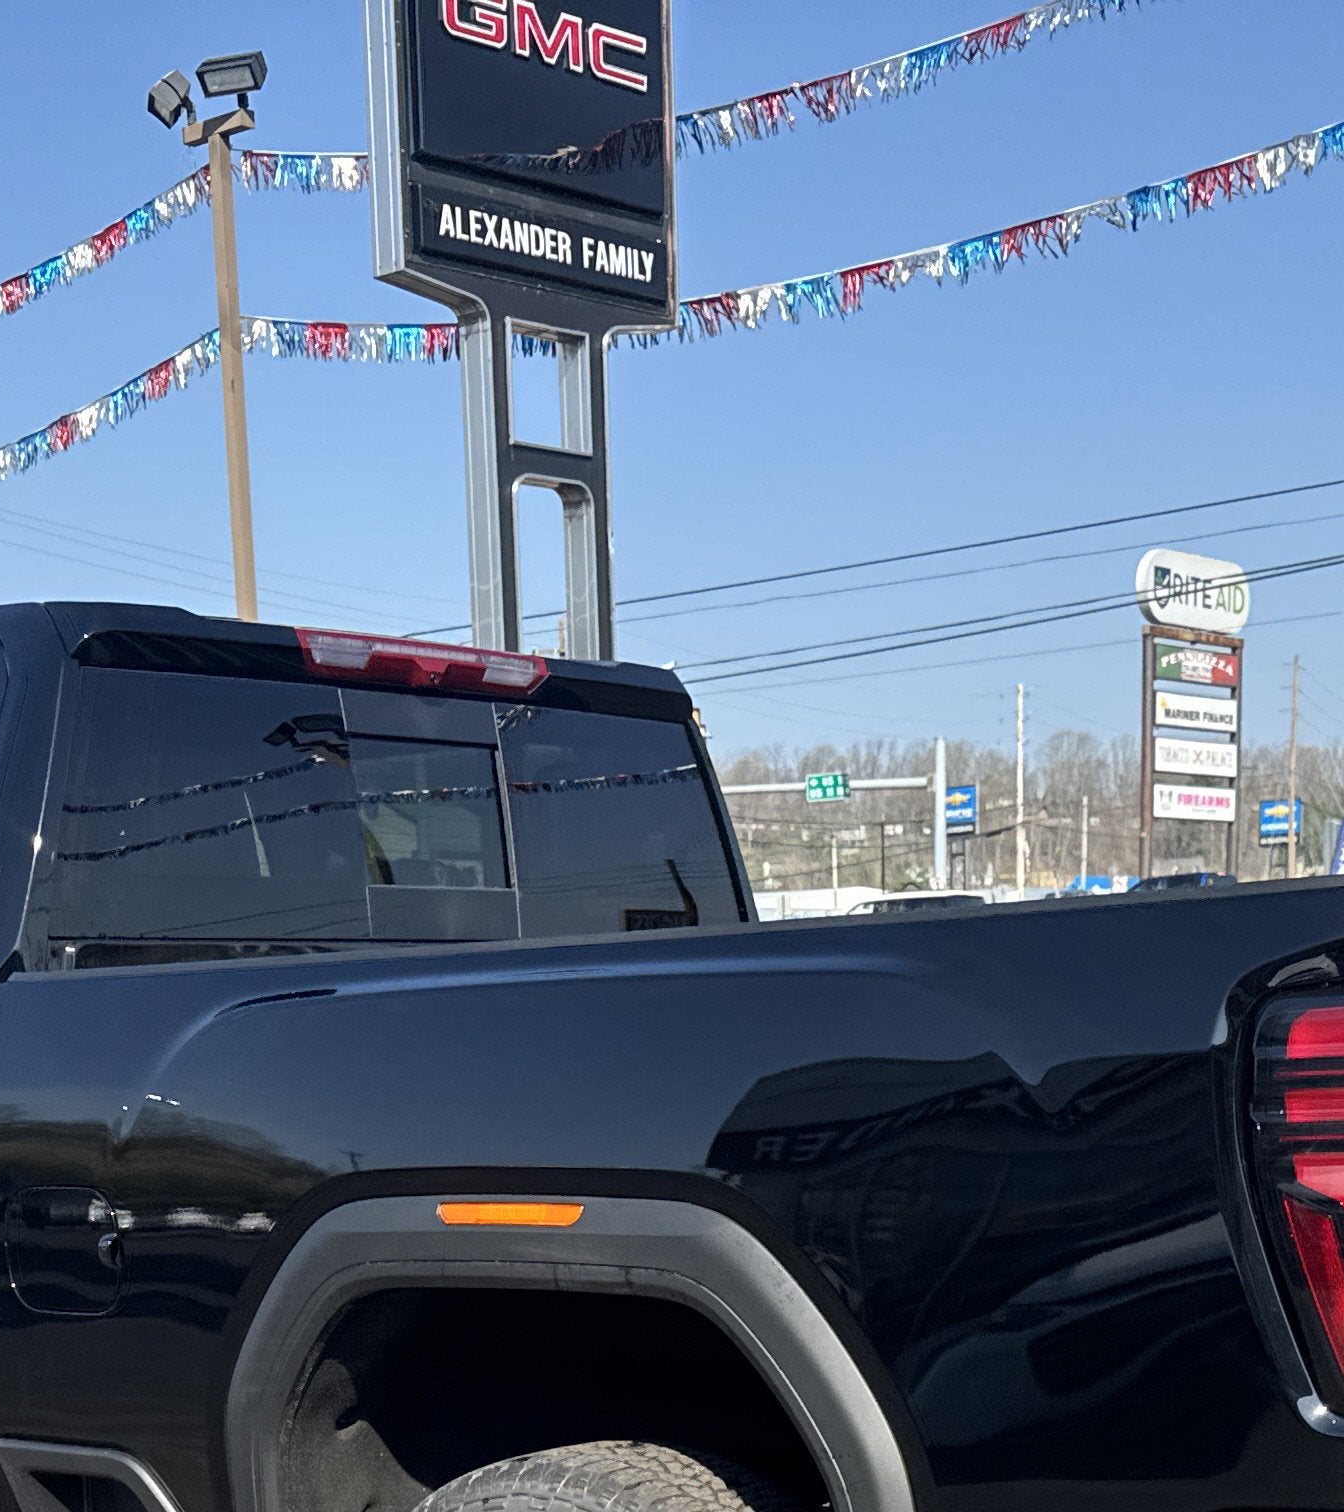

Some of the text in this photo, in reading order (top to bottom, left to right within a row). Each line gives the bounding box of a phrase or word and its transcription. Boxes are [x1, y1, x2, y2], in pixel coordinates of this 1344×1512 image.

[441, 0, 648, 93] GMC
[439, 203, 655, 283] ALEXANDER FAMILY
[1172, 573, 1246, 614] RITE AID
[1164, 708, 1200, 721] MARINER
[1177, 793, 1231, 808] FIREARMS
